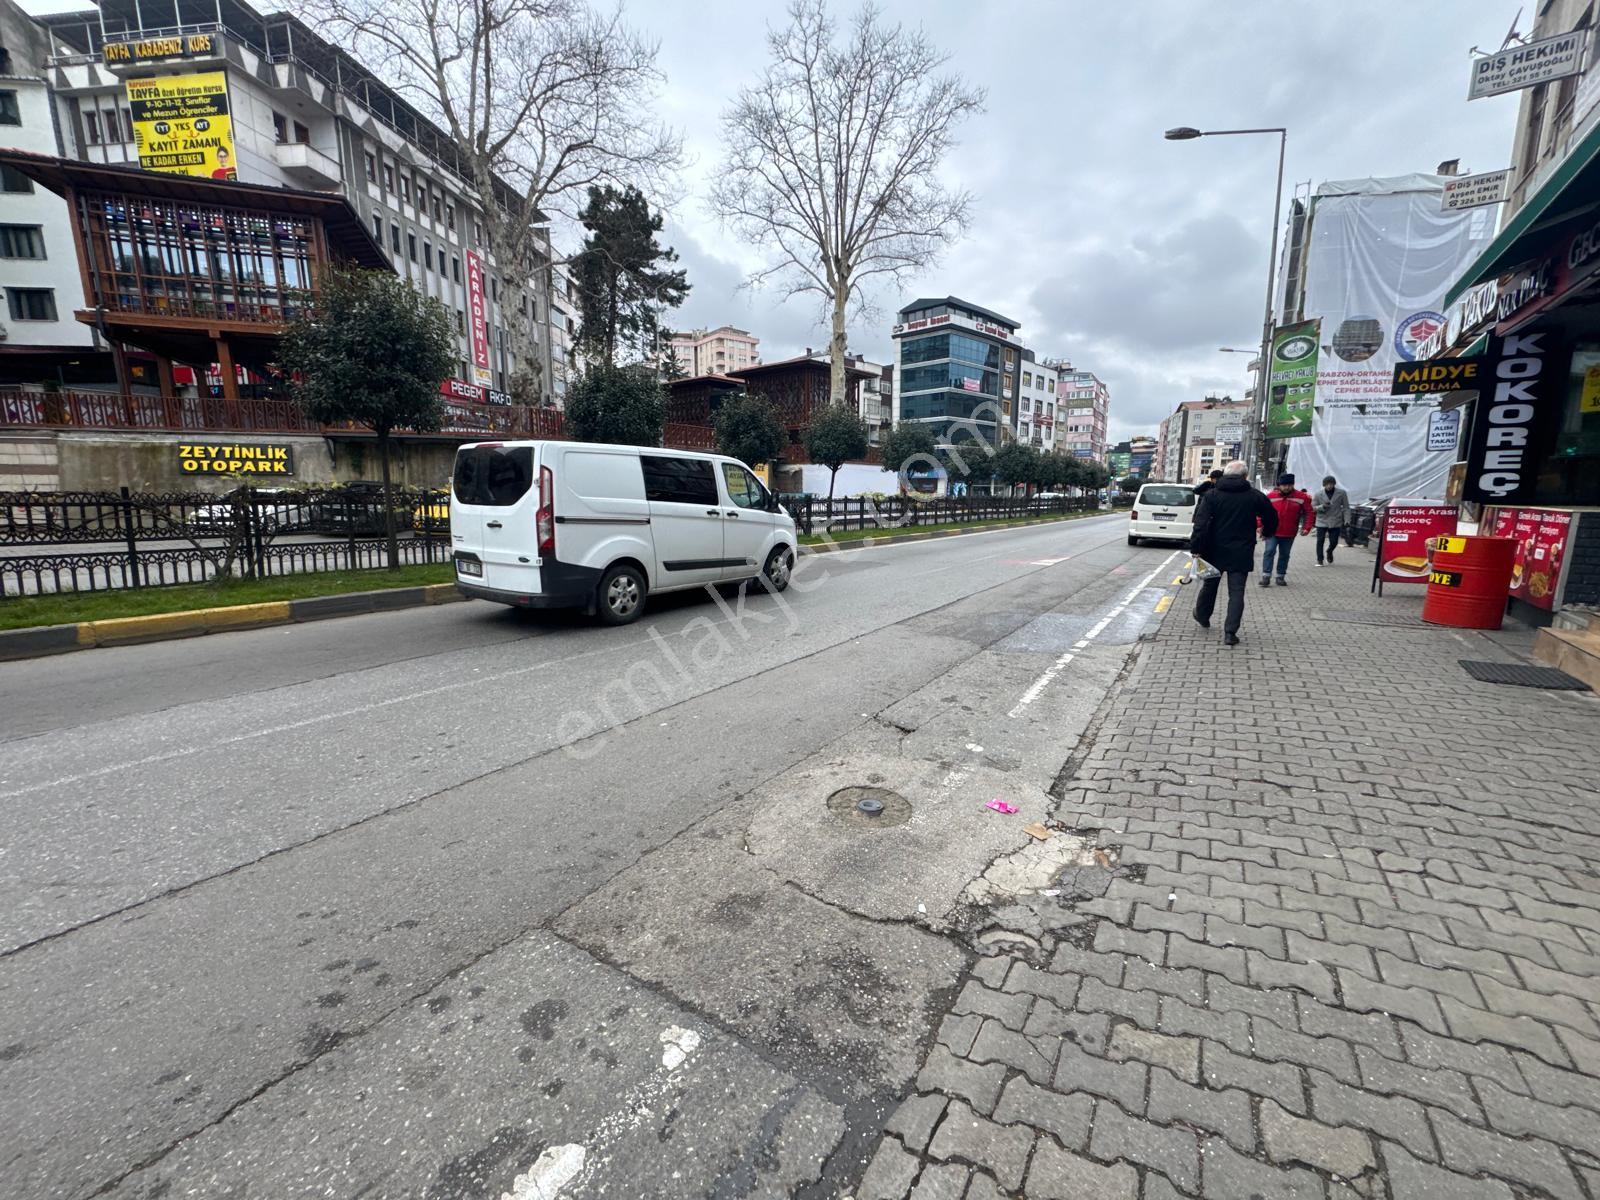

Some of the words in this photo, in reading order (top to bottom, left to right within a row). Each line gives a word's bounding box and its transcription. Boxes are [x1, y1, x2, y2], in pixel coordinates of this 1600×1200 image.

[104, 43, 131, 60] TAYFA
[187, 35, 211, 53] KURS
[129, 87, 160, 100] TAYFA
[153, 108, 178, 117] Mezun
[179, 105, 219, 117] Öğrenciler
[174, 122, 191, 131] YKS
[149, 140, 179, 153] KAYIT
[183, 137, 222, 150] ZAMANI
[141, 157, 152, 167] NE
[153, 155, 177, 166] KADAR
[178, 154, 203, 164] ERKEN
[1397, 361, 1478, 383] MİDYE
[450, 381, 483, 400] PEGEM
[1408, 381, 1461, 392] DOLMA
[1477, 332, 1548, 498] KOKOREÇ
[178, 444, 288, 460] ZEYTİNLİK
[183, 460, 287, 473] OTOPARK
[1388, 508, 1426, 516] Ekmek
[1427, 508, 1457, 516] Arası
[1388, 516, 1432, 526] Kokoreç
